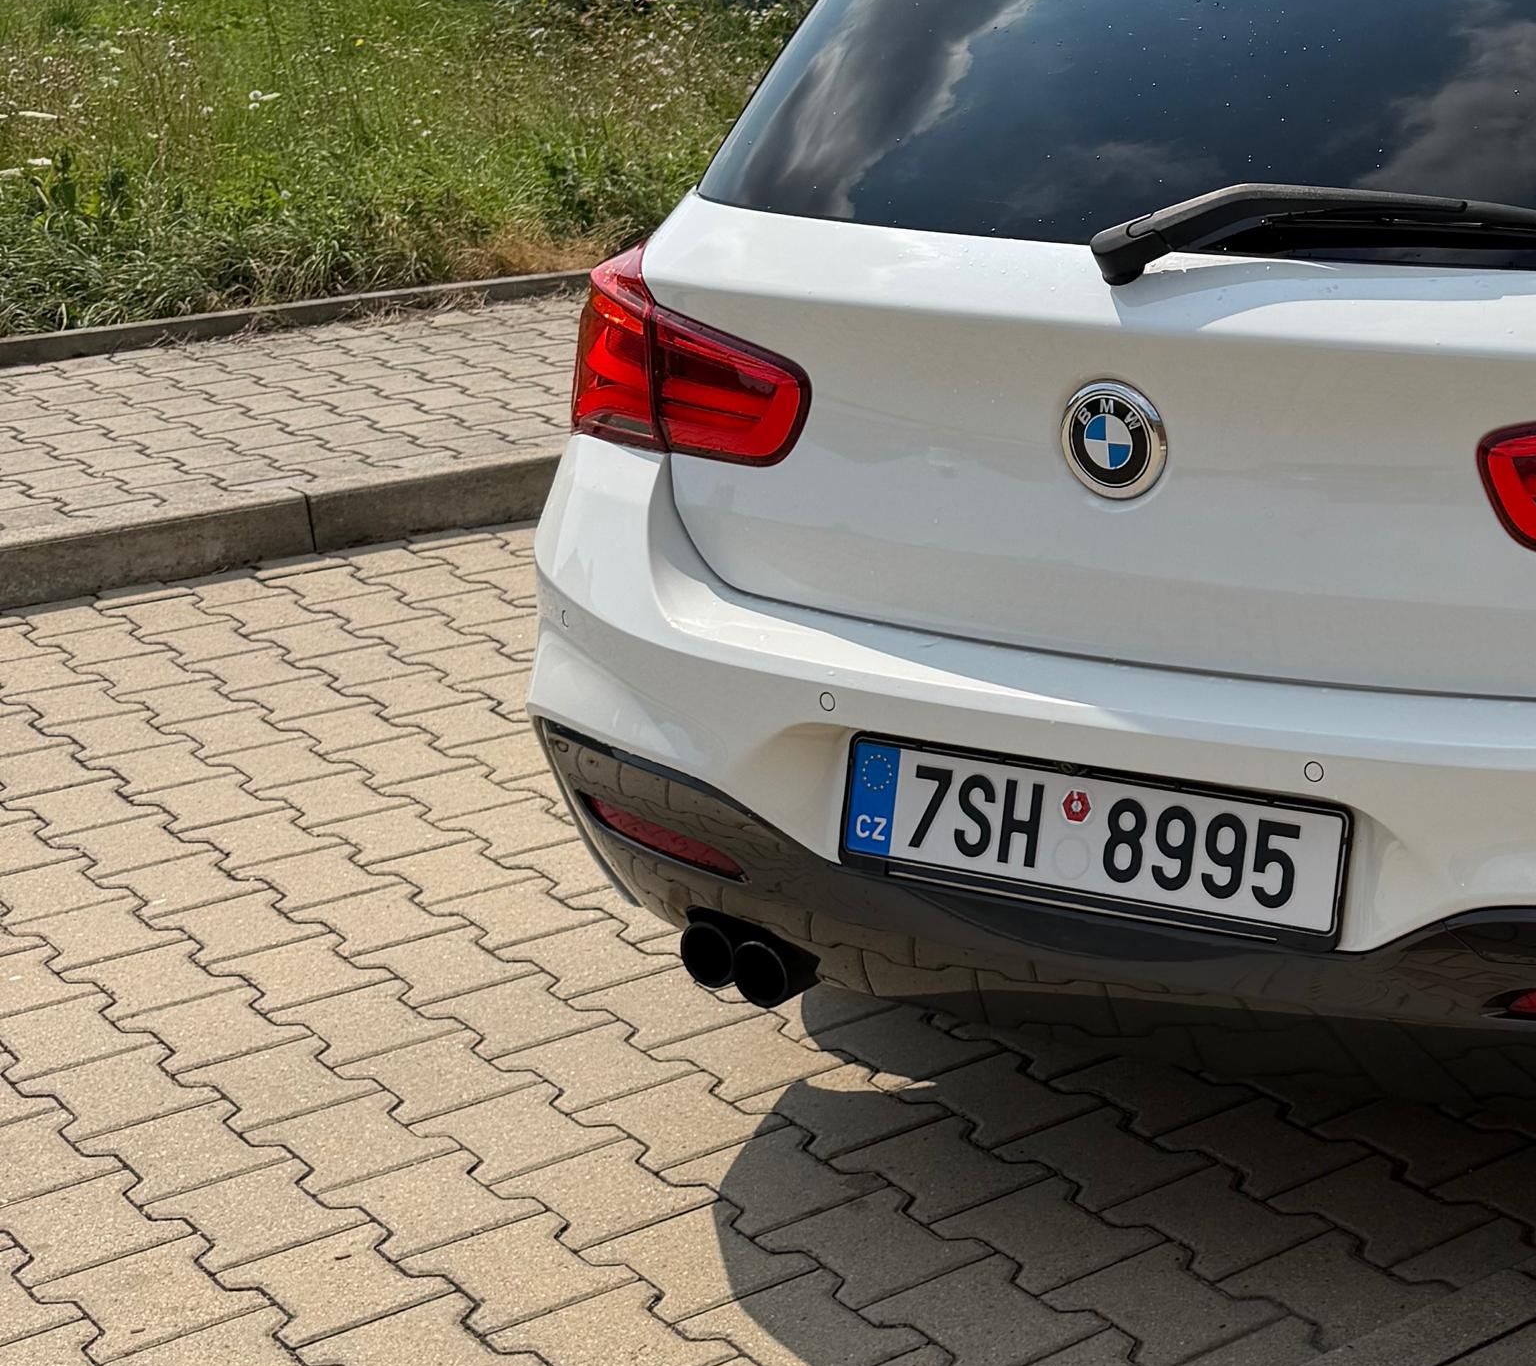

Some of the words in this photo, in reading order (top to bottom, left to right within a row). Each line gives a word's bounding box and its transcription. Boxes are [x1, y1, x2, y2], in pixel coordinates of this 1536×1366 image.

[1077, 398, 1141, 430] BMW
[856, 814, 887, 841] CZ
[908, 764, 1045, 868] 7SH
[1102, 797, 1301, 909] 8995
